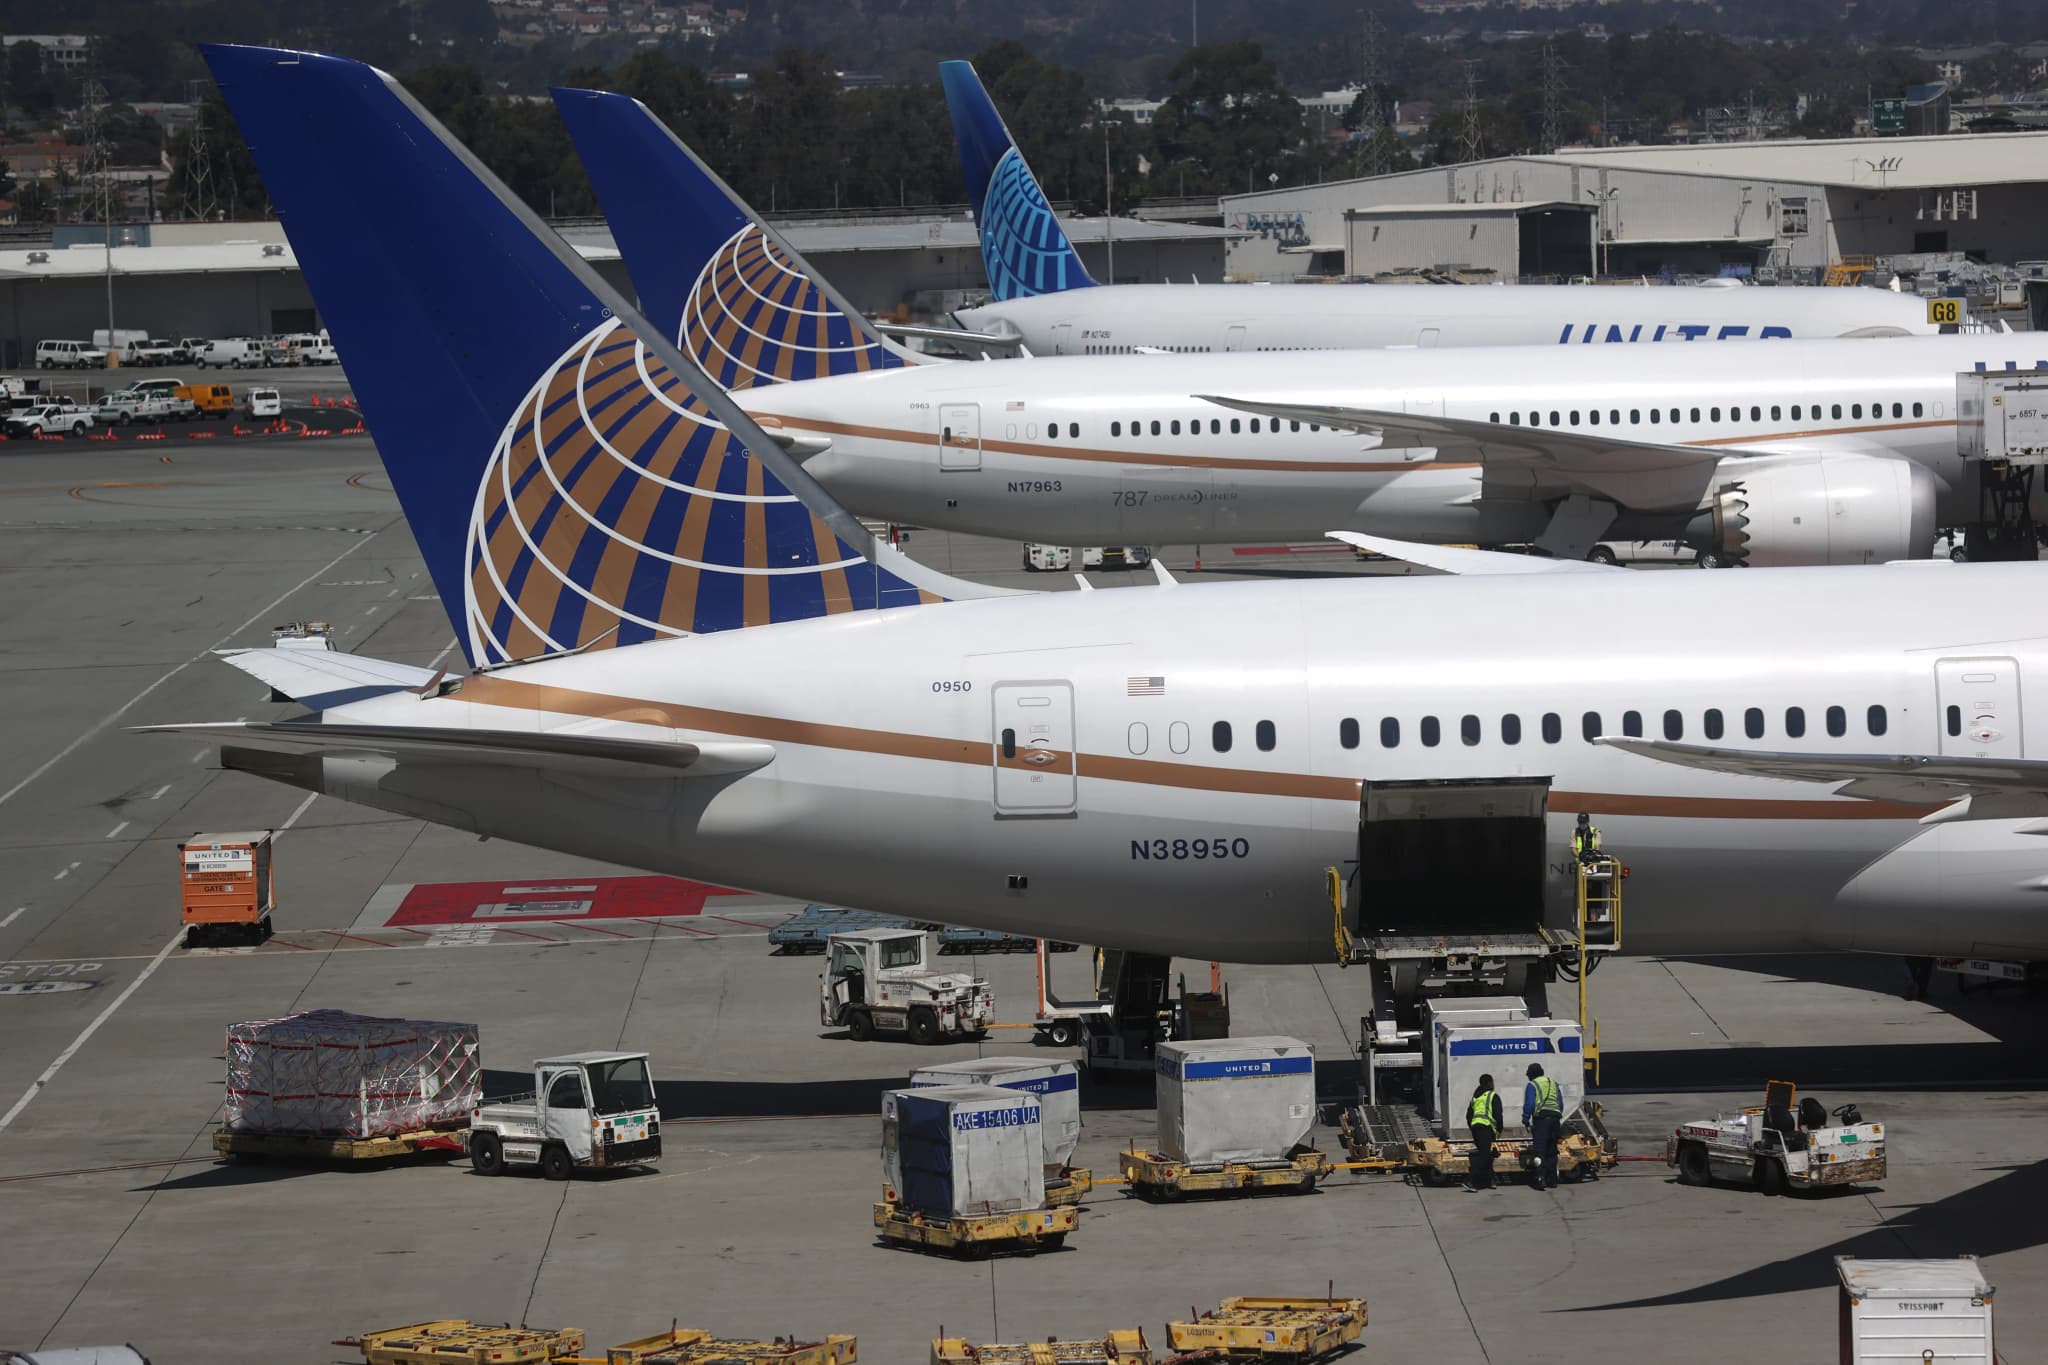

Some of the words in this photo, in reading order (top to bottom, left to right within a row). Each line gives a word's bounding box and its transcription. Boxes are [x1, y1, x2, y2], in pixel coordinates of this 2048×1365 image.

[1933, 303, 1956, 322] G8
[909, 402, 930, 410] 0963
[2019, 409, 2037, 418] 6857
[1007, 480, 1062, 493] N17963
[1111, 490, 1149, 507] 787
[932, 680, 972, 693] 0950
[1131, 837, 1250, 861] N38950
[194, 852, 230, 860] UNITED
[204, 885, 224, 893] GATE
[1491, 1043, 1527, 1051] UNITED
[1225, 1064, 1260, 1073] UNITED
[956, 1112, 979, 1130] AKE
[982, 1109, 1018, 1127] 15406
[1022, 1107, 1038, 1124] UA
[1898, 1302, 1944, 1312] SWISSPORT
